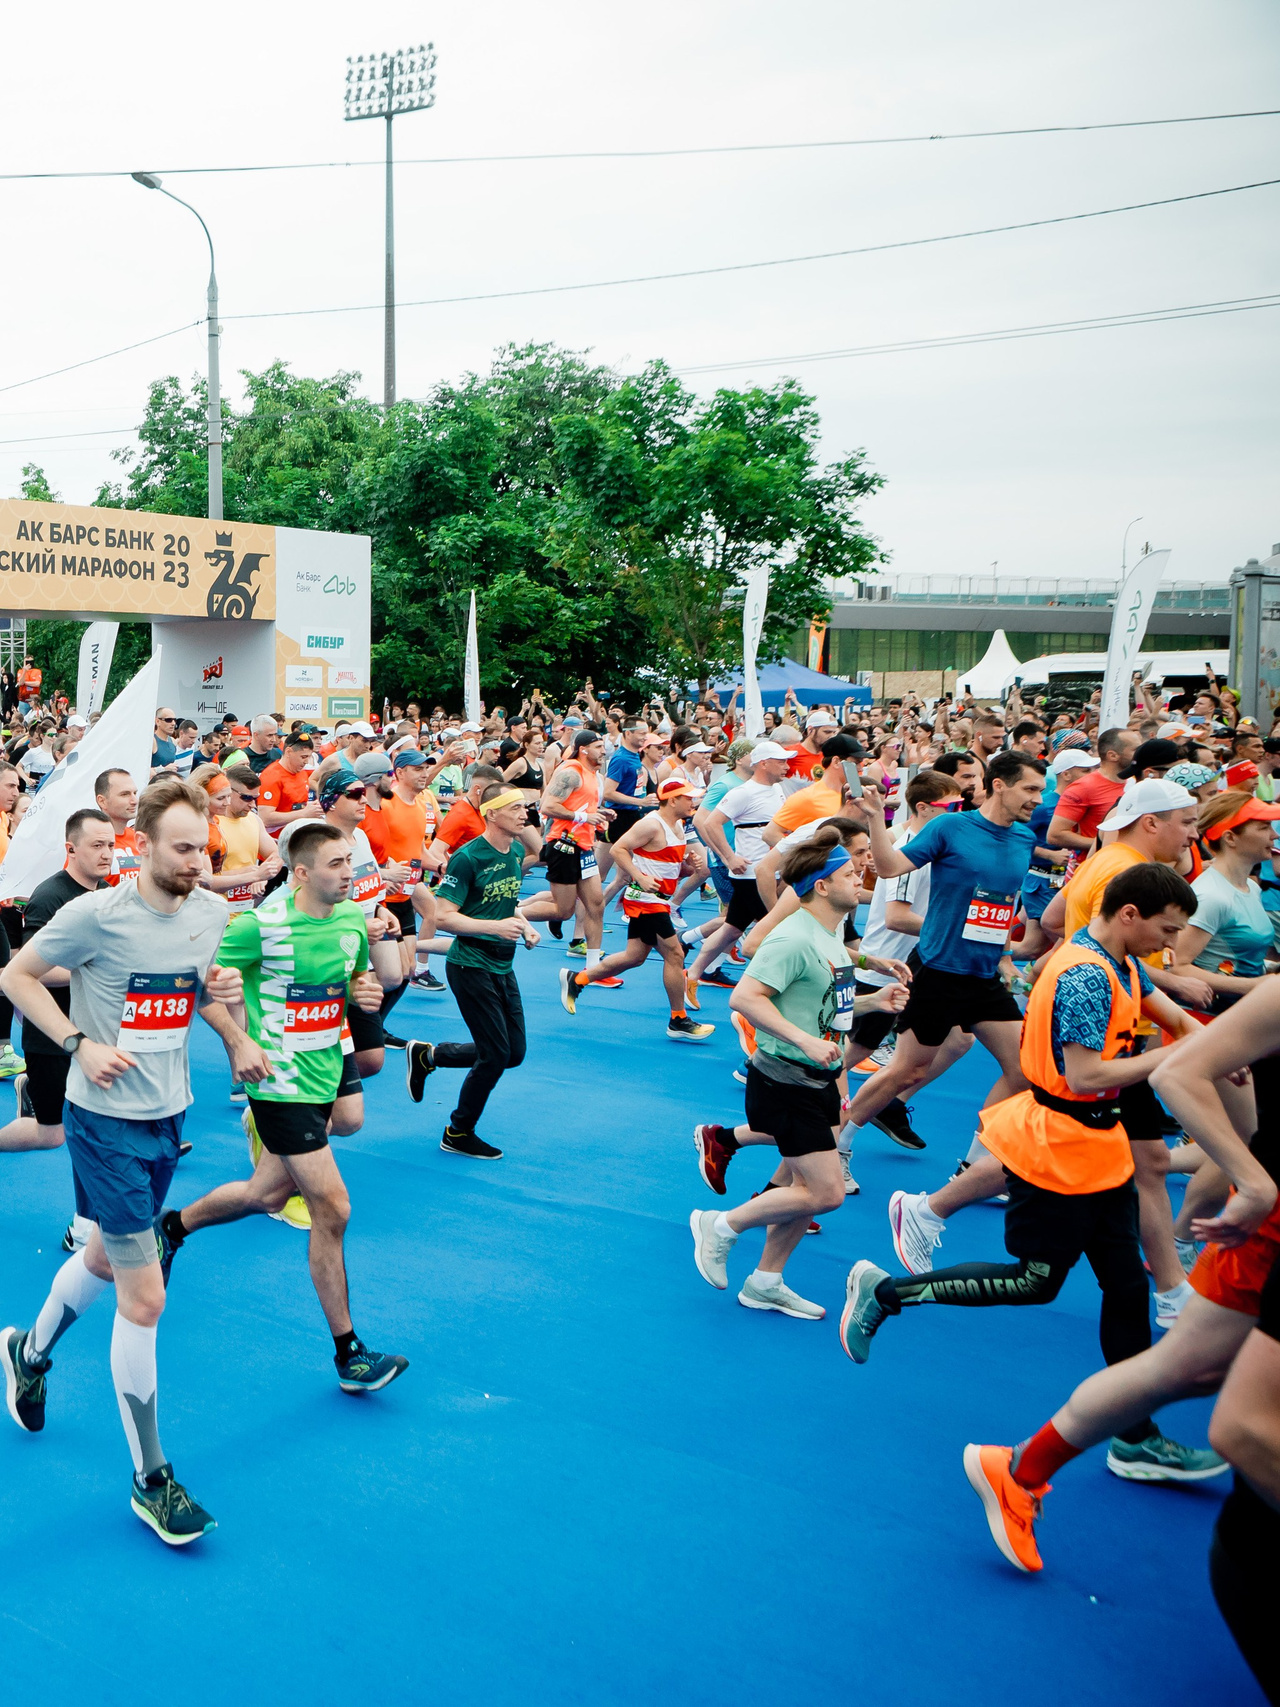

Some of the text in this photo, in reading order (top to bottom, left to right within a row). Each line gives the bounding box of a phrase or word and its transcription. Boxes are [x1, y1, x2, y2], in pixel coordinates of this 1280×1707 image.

[16, 521, 155, 552] АК БАРС БАНК
[163, 534, 190, 558] 20
[61, 553, 156, 582] МАРАФОН
[163, 561, 190, 588] 23
[296, 571, 321, 583] Ак Барс
[307, 635, 344, 649] СИБУР
[289, 703, 318, 711] DIGINAVIS
[359, 877, 379, 894] 3844
[978, 906, 1011, 922] 3180
[125, 998, 188, 1017] A 4138
[296, 1003, 340, 1022] 4449
[932, 1279, 982, 1300] HERO
